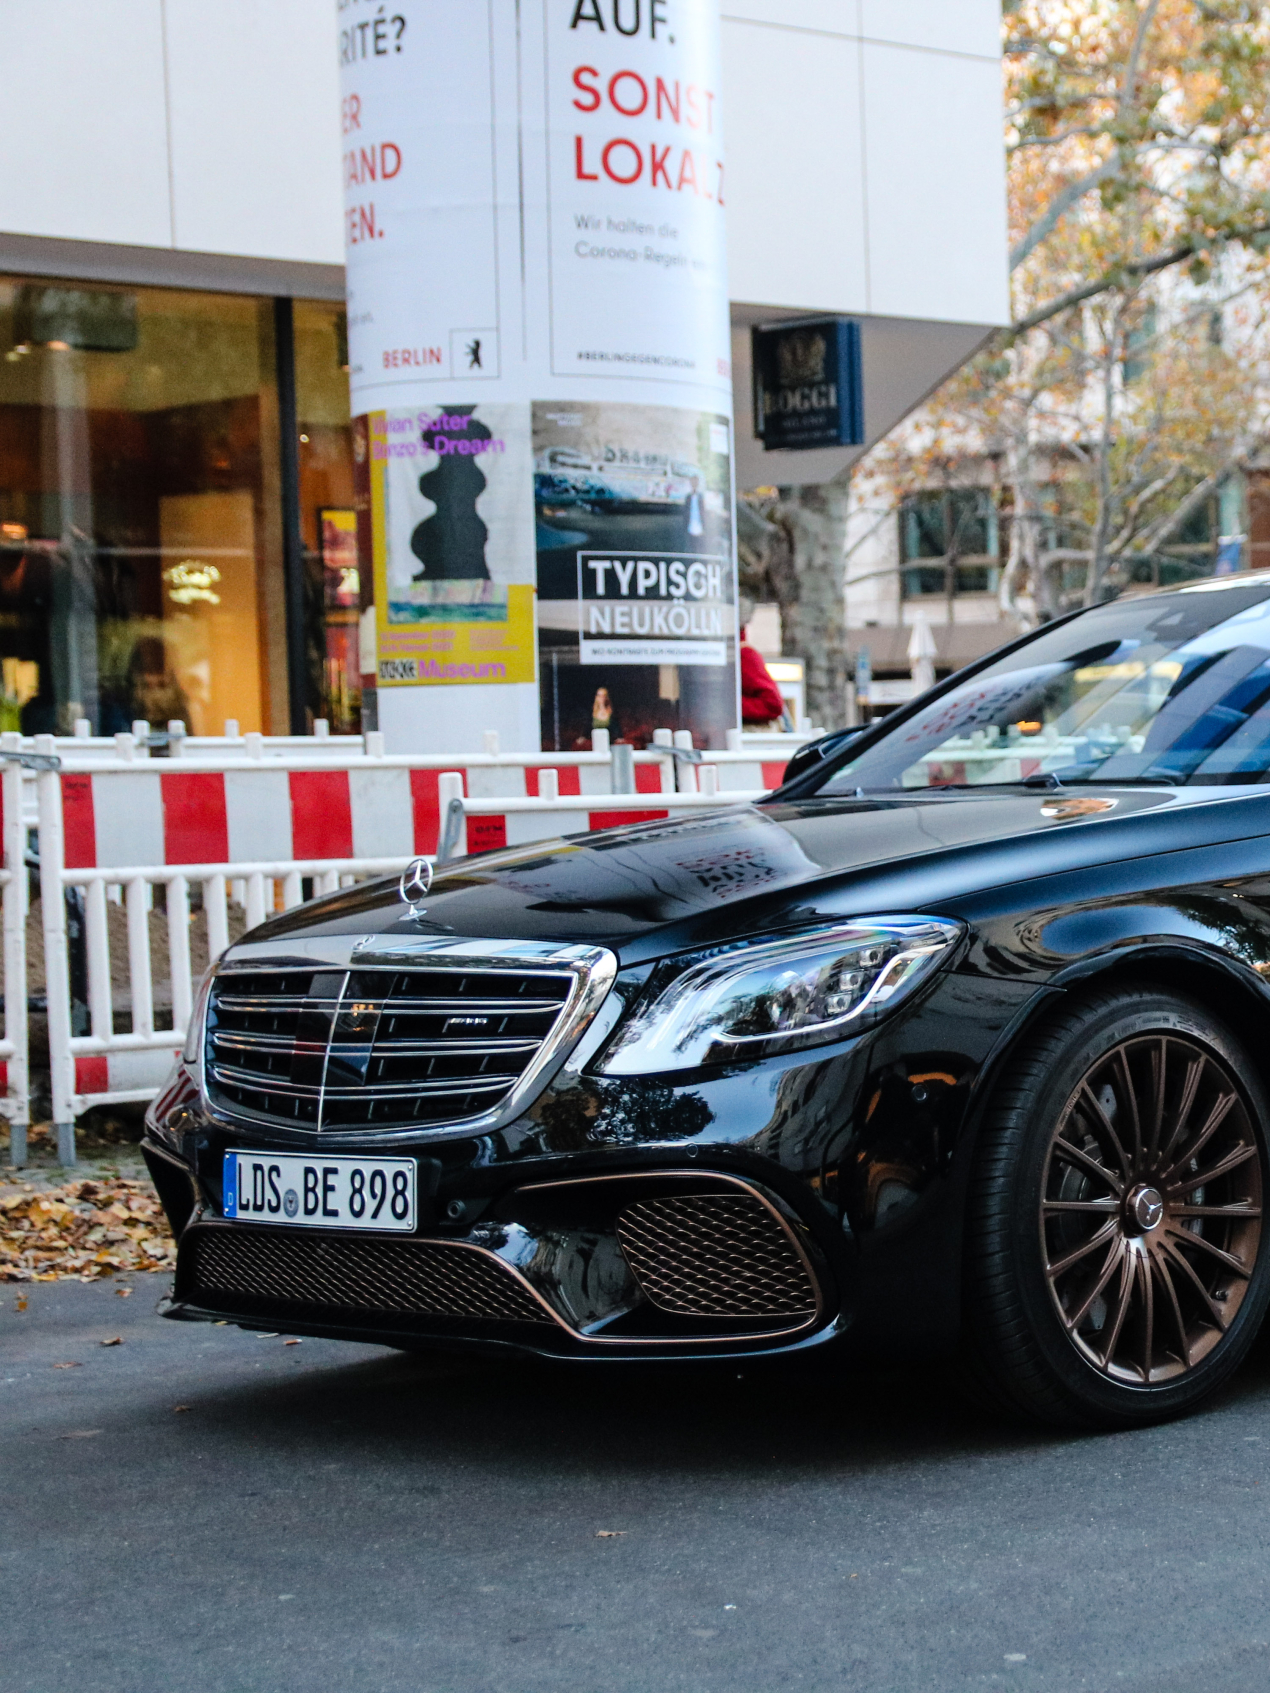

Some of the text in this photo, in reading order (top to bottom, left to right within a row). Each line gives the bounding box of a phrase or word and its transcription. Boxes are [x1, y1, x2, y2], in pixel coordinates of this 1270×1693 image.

[569, 0, 676, 45] AUF.
[572, 65, 715, 134] SONST
[574, 213, 679, 239] Wir halten die
[382, 346, 442, 370] BERLIN
[417, 411, 473, 432] Suter
[434, 435, 506, 456] Dream
[587, 559, 722, 599] TYPISCH
[588, 598, 722, 635] NEUKÖLLN
[418, 659, 507, 678] Museum
[238, 1162, 410, 1221] LDS BE 898
